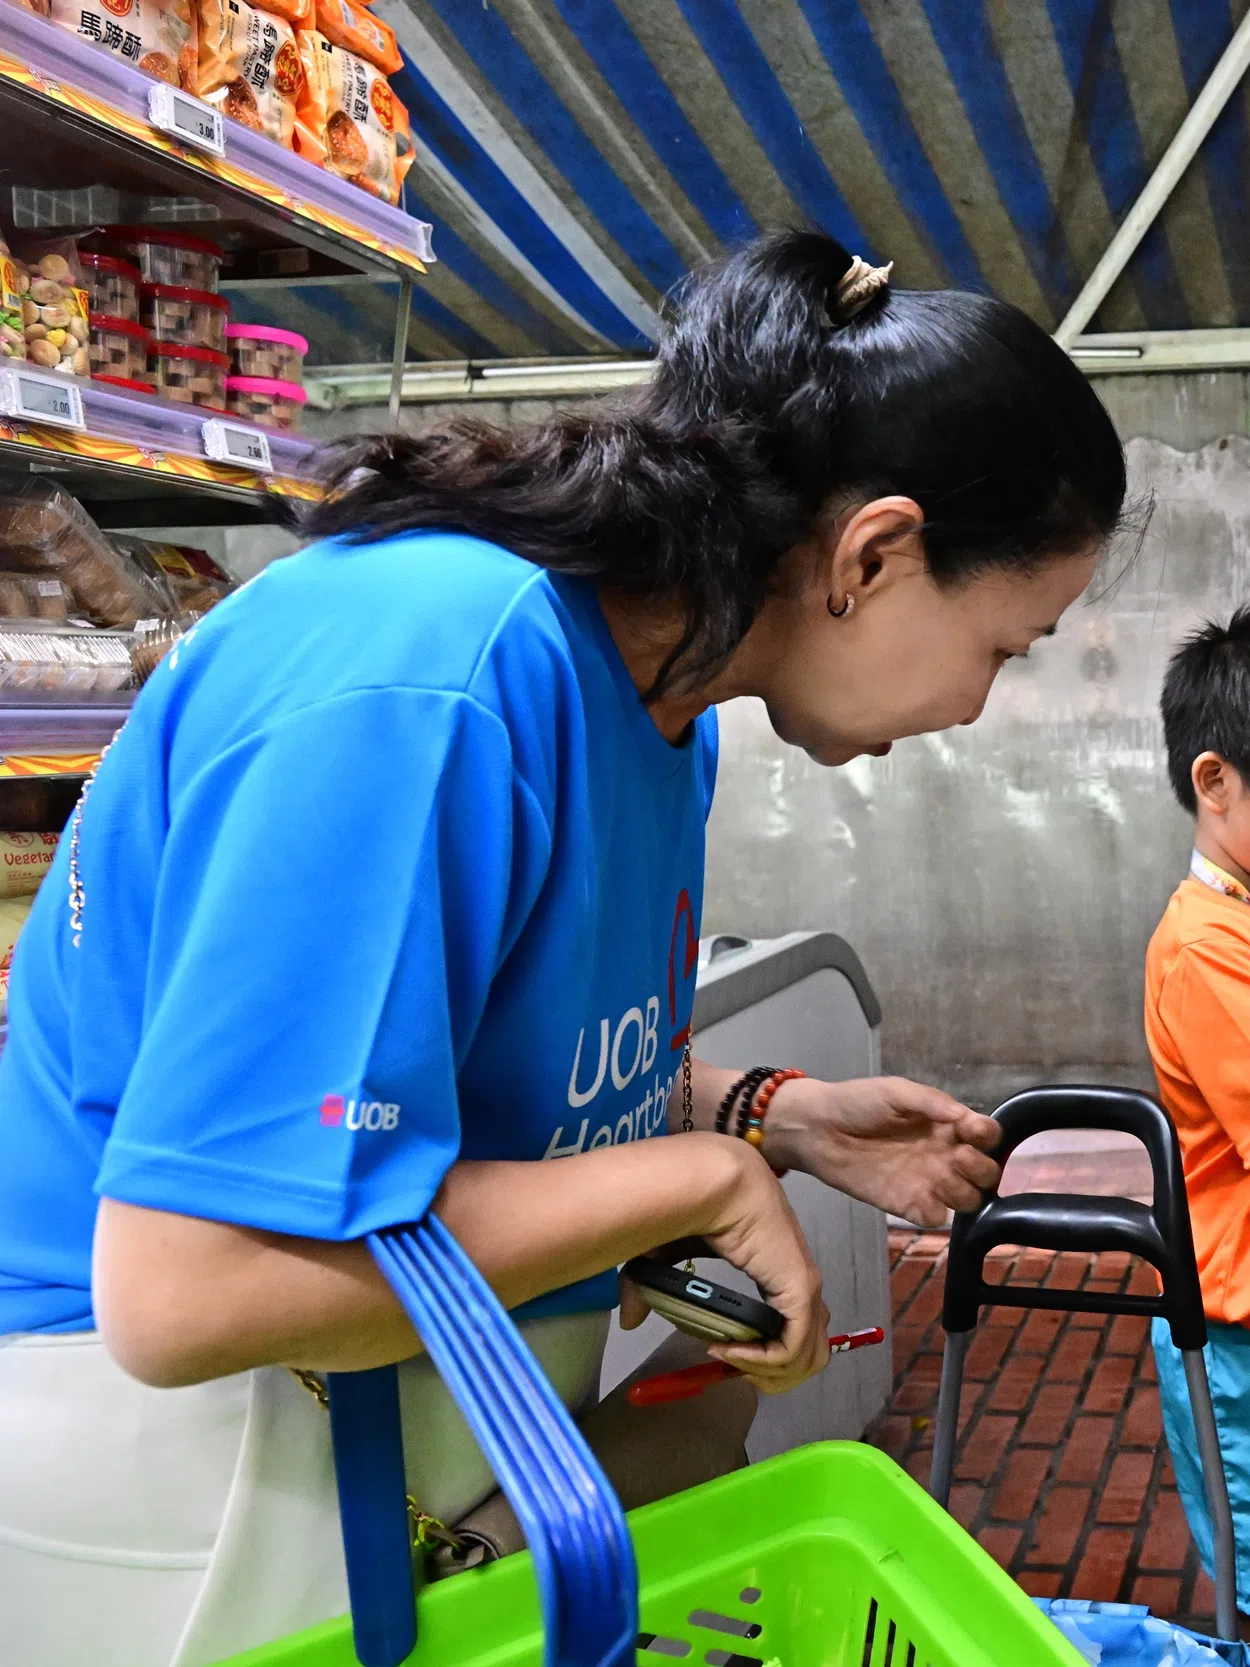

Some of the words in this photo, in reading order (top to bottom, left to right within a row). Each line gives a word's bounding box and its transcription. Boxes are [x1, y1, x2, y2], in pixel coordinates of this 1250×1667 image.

[243, 43, 260, 80] PASTRY
[199, 122, 215, 141] 3.00
[52, 400, 70, 415] 2.00
[567, 995, 660, 1108] UOB
[346, 1100, 401, 1131] UOB
[541, 1068, 680, 1161] Heartbe
